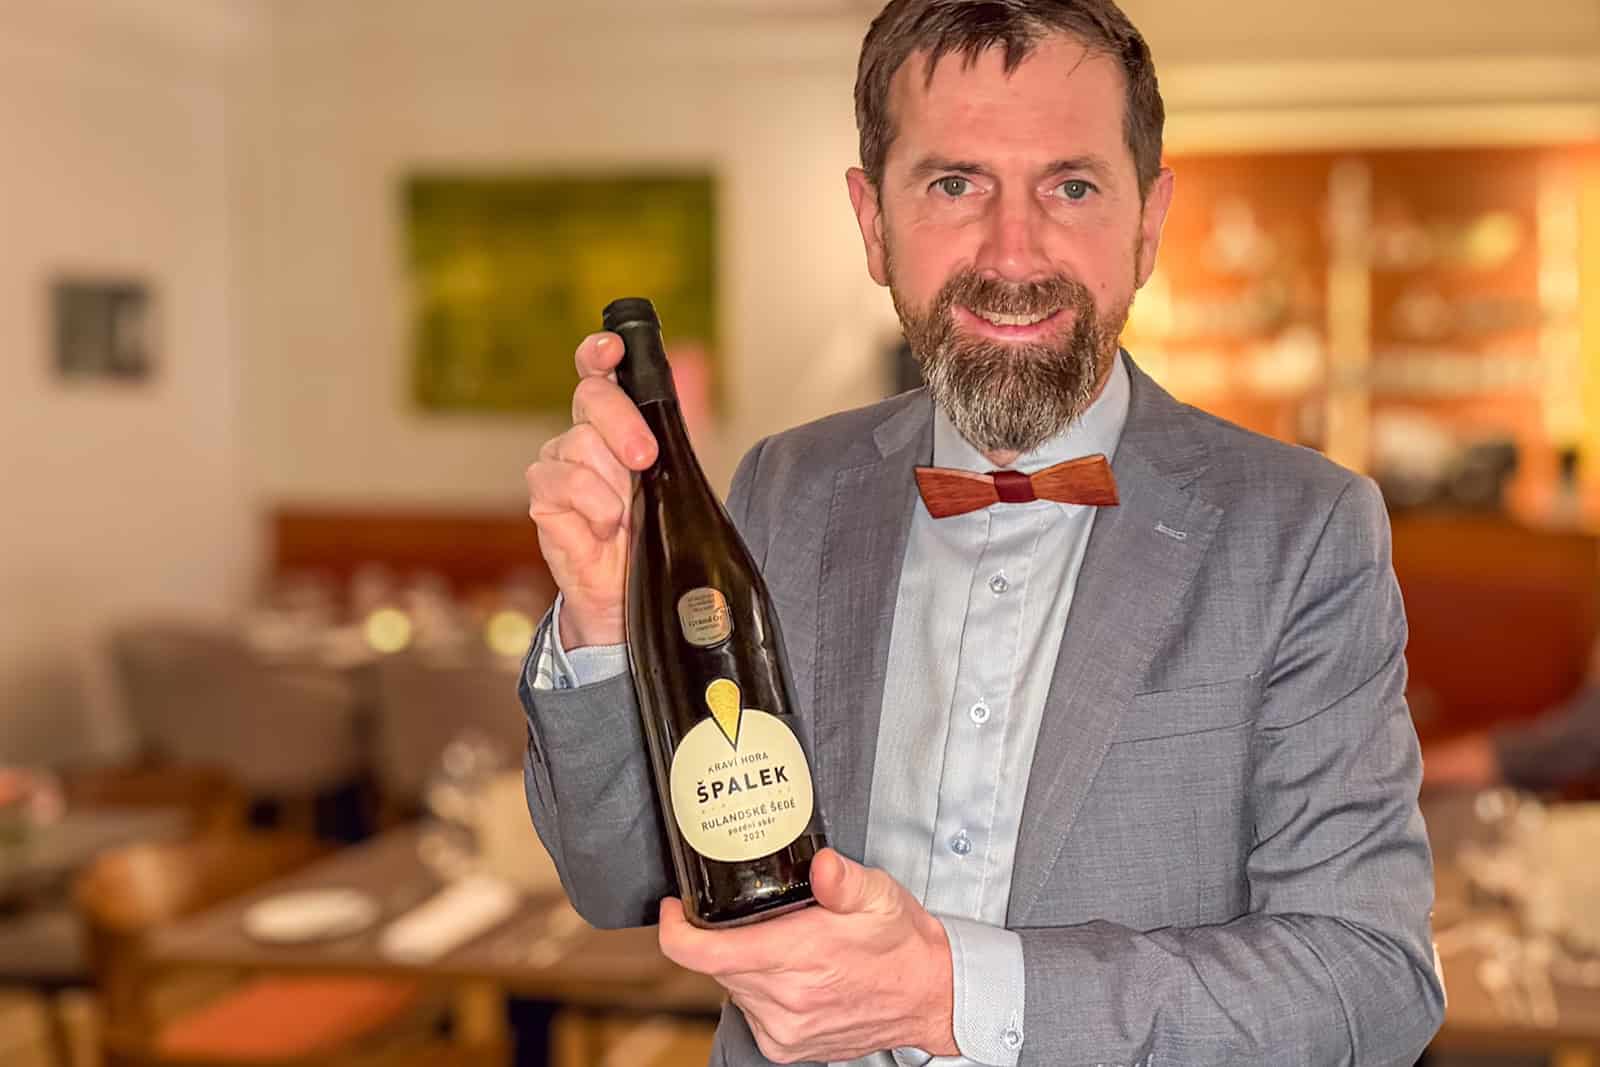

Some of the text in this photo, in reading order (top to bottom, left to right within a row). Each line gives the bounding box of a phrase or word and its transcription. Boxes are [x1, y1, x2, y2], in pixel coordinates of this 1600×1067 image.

[741, 752, 769, 767] HORA
[697, 765, 789, 803] ŠPALEK
[701, 804, 768, 832] RULANDSKÉ
[770, 797, 797, 813] ŠEDÉ
[743, 830, 766, 842] 2021
